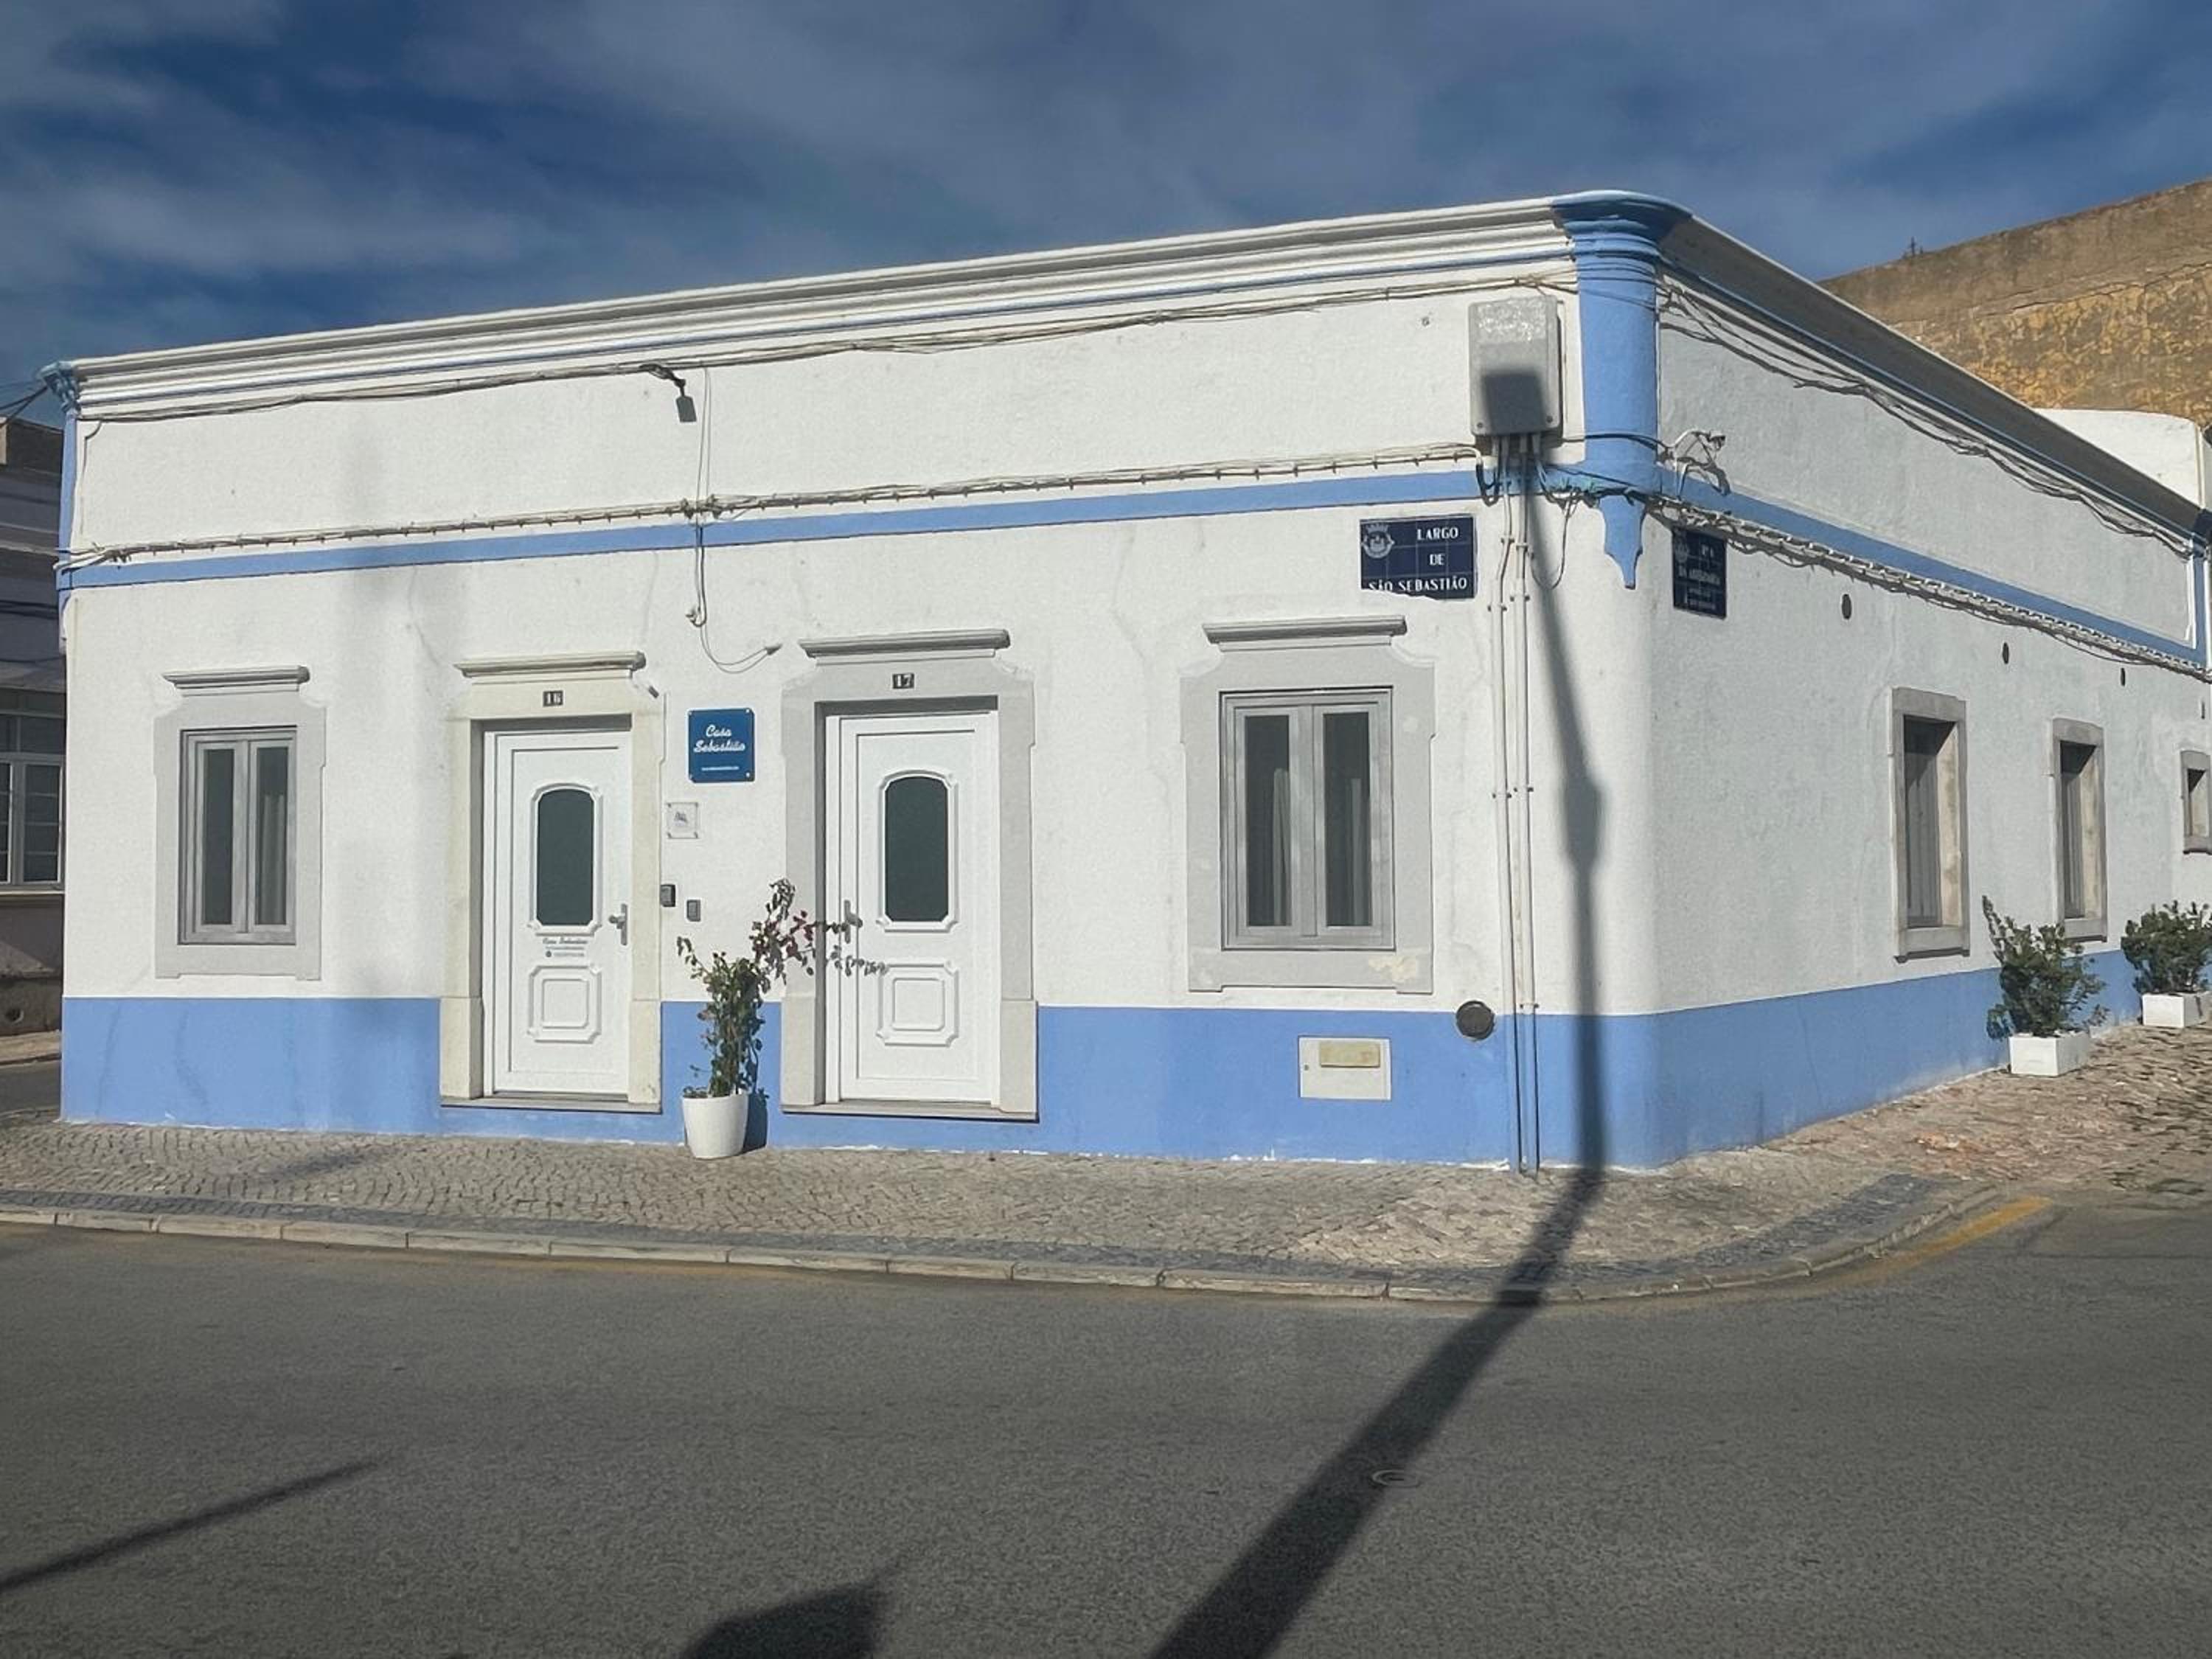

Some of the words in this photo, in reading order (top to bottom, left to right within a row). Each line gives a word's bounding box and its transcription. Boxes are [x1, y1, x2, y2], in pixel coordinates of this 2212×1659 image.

[1416, 526, 1459, 541] LARGO
[1429, 553, 1445, 566] DE
[1398, 575, 1467, 593] SEBASTIÃO
[897, 674, 912, 687] 17
[706, 723, 732, 737] Casa
